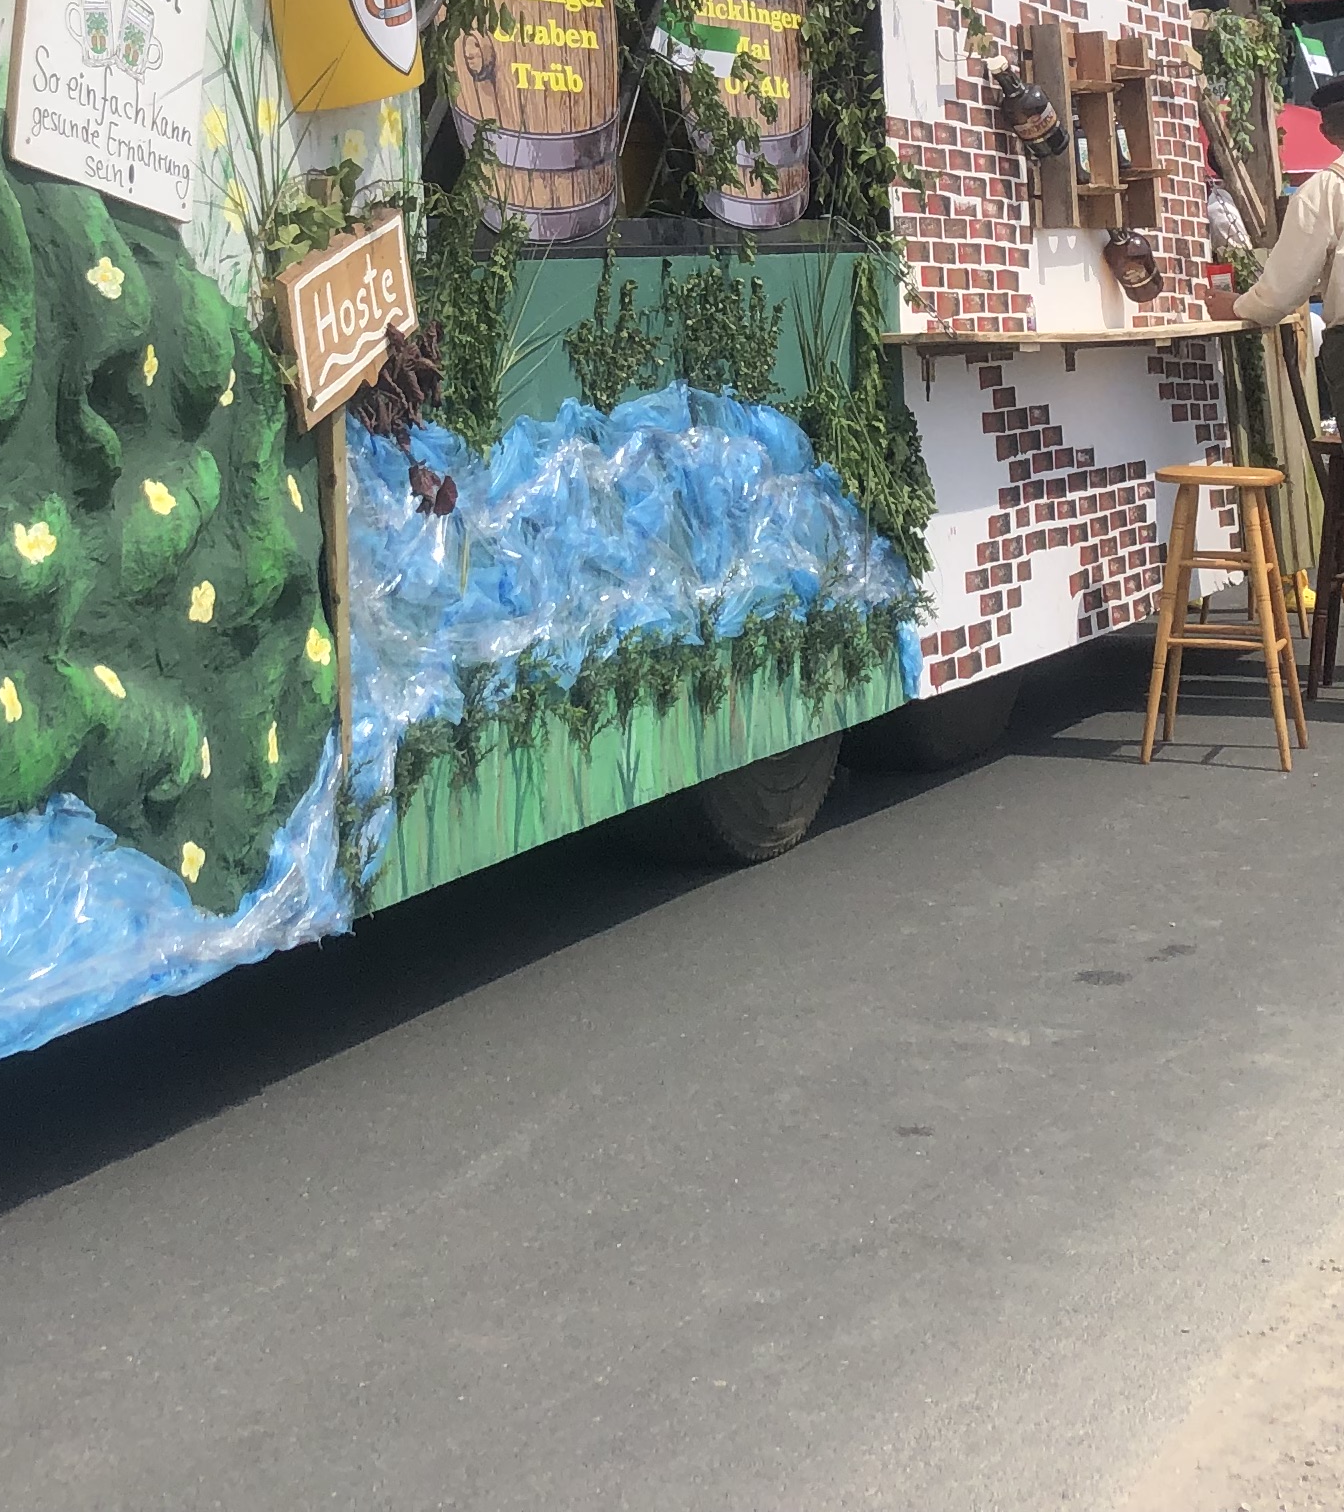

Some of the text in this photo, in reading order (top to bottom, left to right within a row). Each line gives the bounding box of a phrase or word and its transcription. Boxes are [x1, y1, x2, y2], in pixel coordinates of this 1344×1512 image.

[33, 45, 61, 93] So
[66, 65, 147, 125] einfach
[511, 62, 584, 93] Trüb
[31, 106, 190, 199] gesunde Ernährung
[314, 253, 397, 353] Hoste
